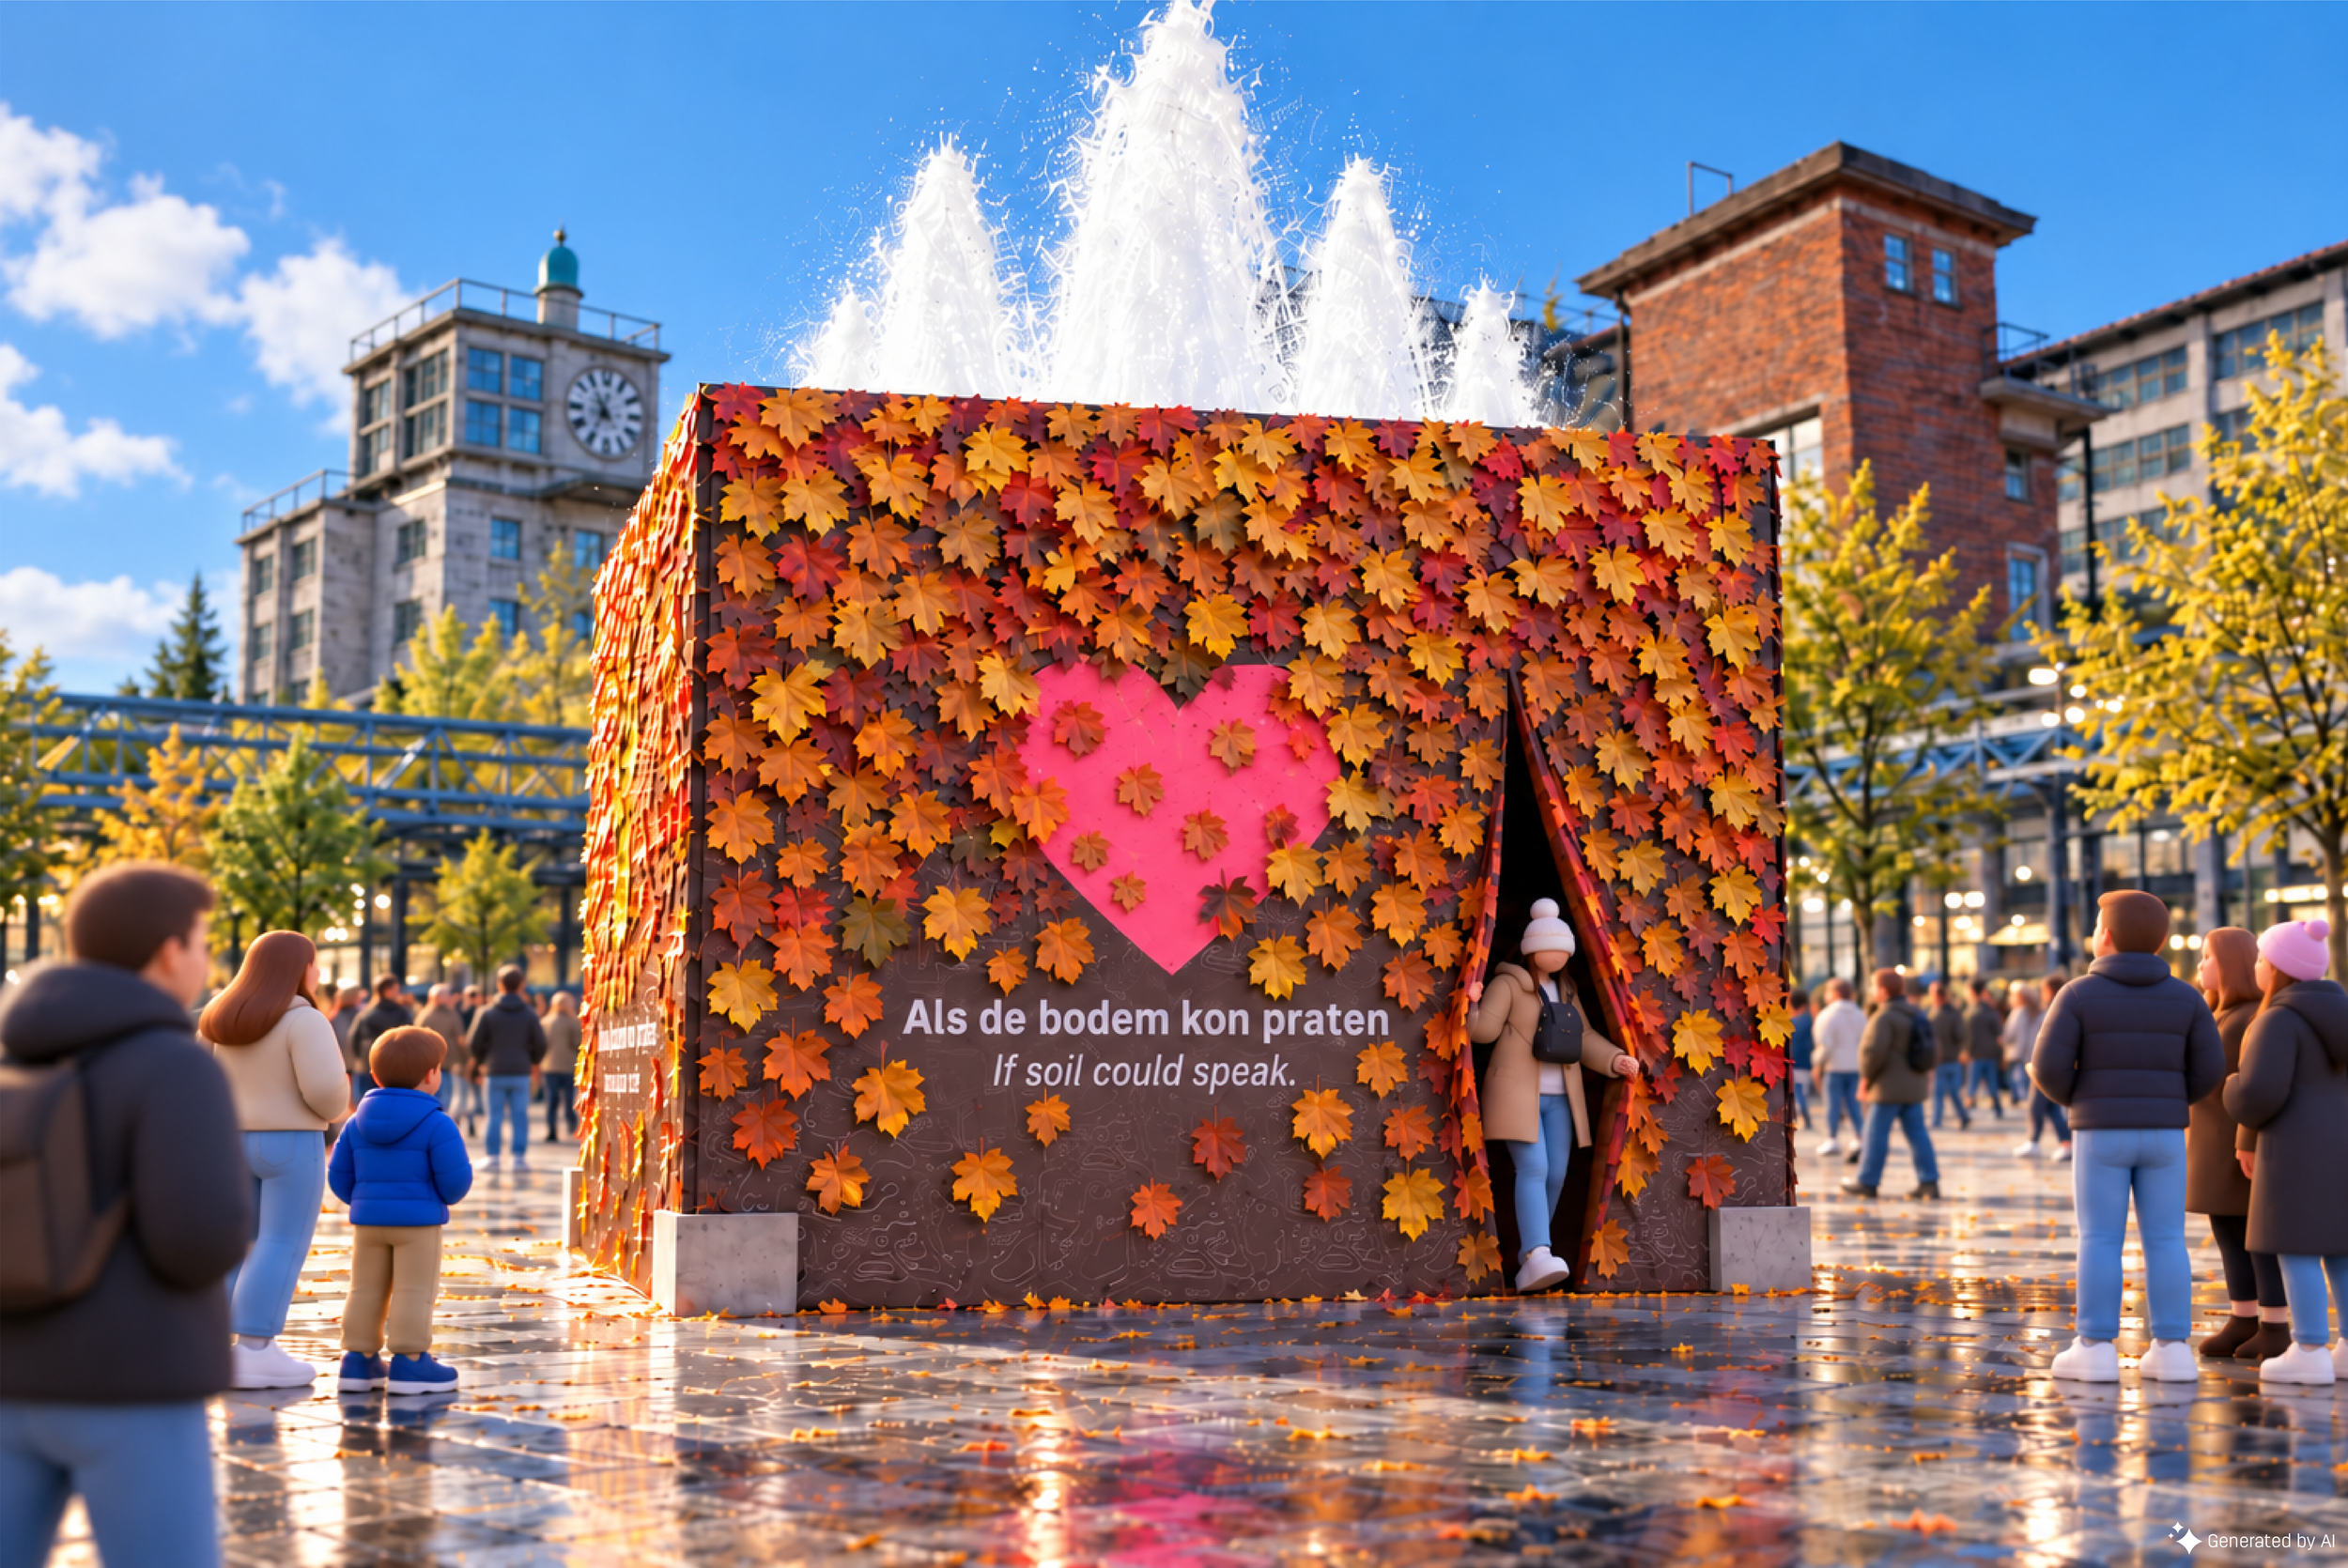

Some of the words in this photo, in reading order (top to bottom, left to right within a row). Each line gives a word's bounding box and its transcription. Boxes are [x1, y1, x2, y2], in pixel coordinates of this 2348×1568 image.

[903, 998, 967, 1035] Als
[980, 999, 1027, 1035] de
[1040, 999, 1169, 1036] bodem
[1182, 999, 1249, 1036] kon
[1263, 1004, 1389, 1044] praten
[993, 1053, 1019, 1086] If
[1026, 1053, 1084, 1086] soil
[1093, 1053, 1184, 1086] could
[1192, 1053, 1296, 1096] speak.
